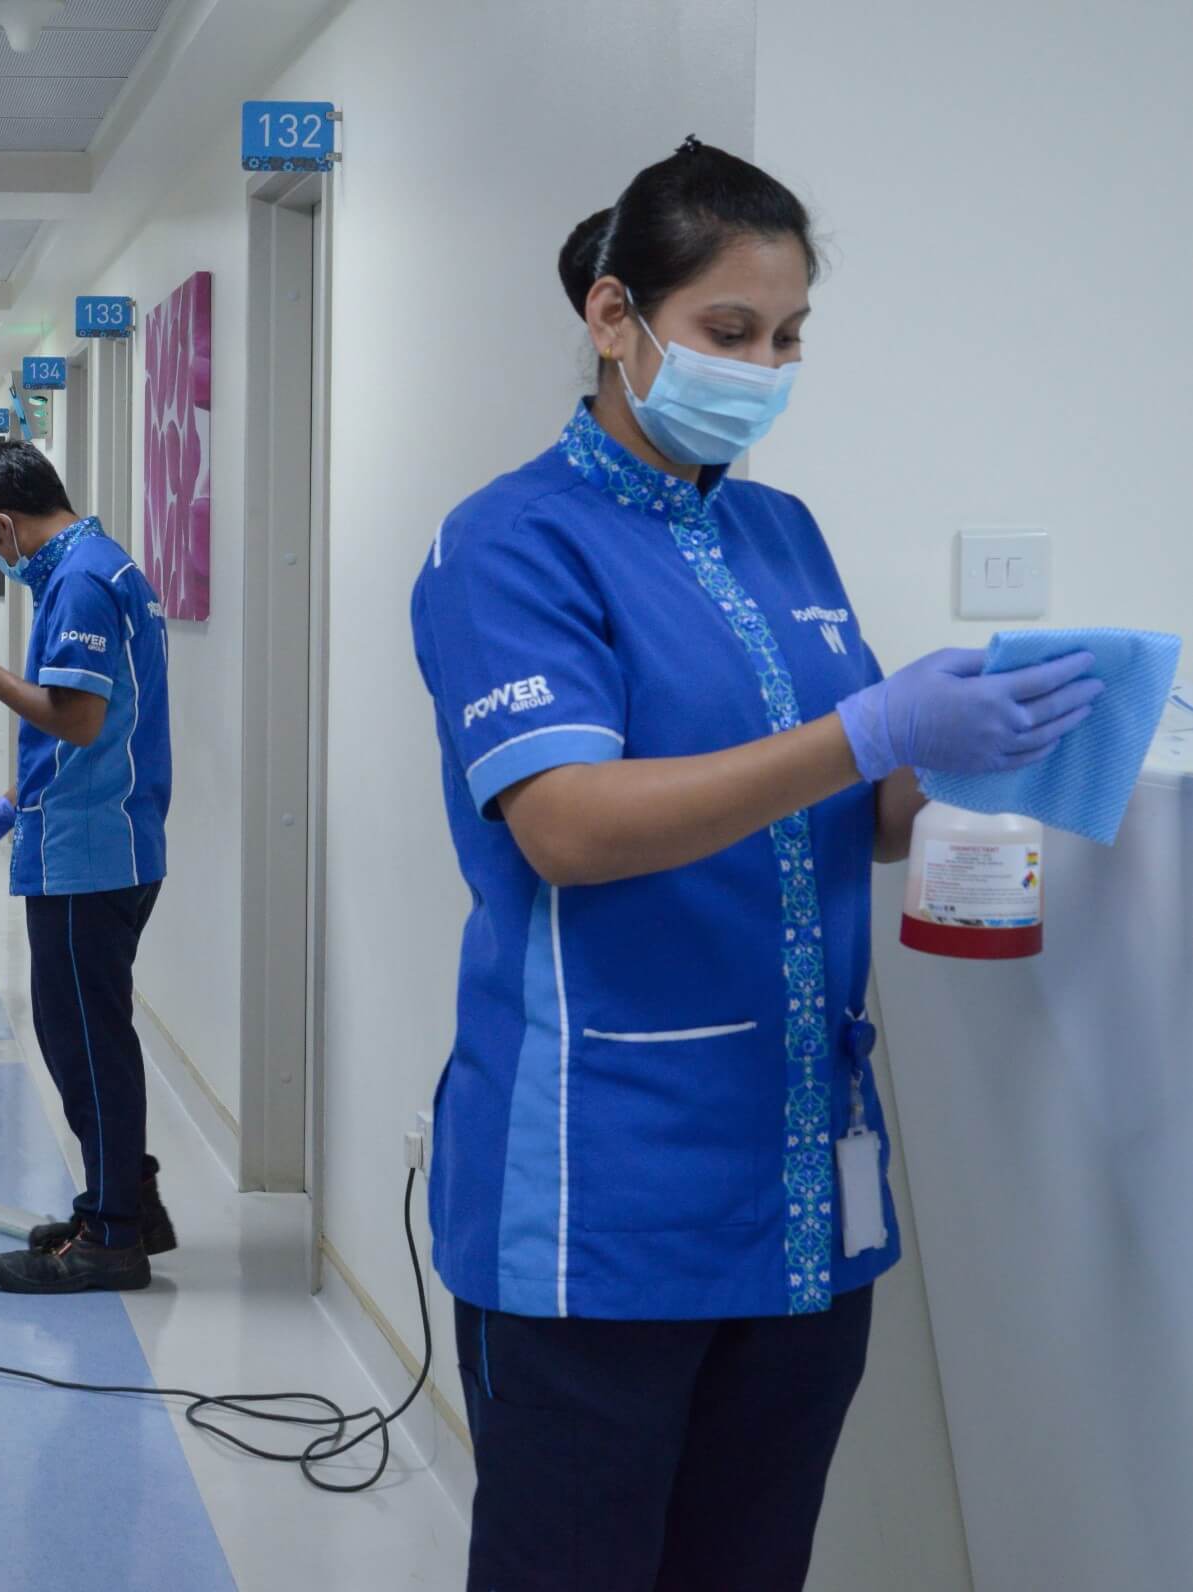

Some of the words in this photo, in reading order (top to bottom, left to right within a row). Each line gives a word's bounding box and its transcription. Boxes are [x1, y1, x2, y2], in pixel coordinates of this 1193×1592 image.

[258, 112, 322, 149] 132
[84, 302, 124, 325] 133
[28, 361, 61, 380] 134
[60, 630, 107, 649] POWER
[463, 674, 551, 729] POWER
[509, 693, 556, 713] GROUP
